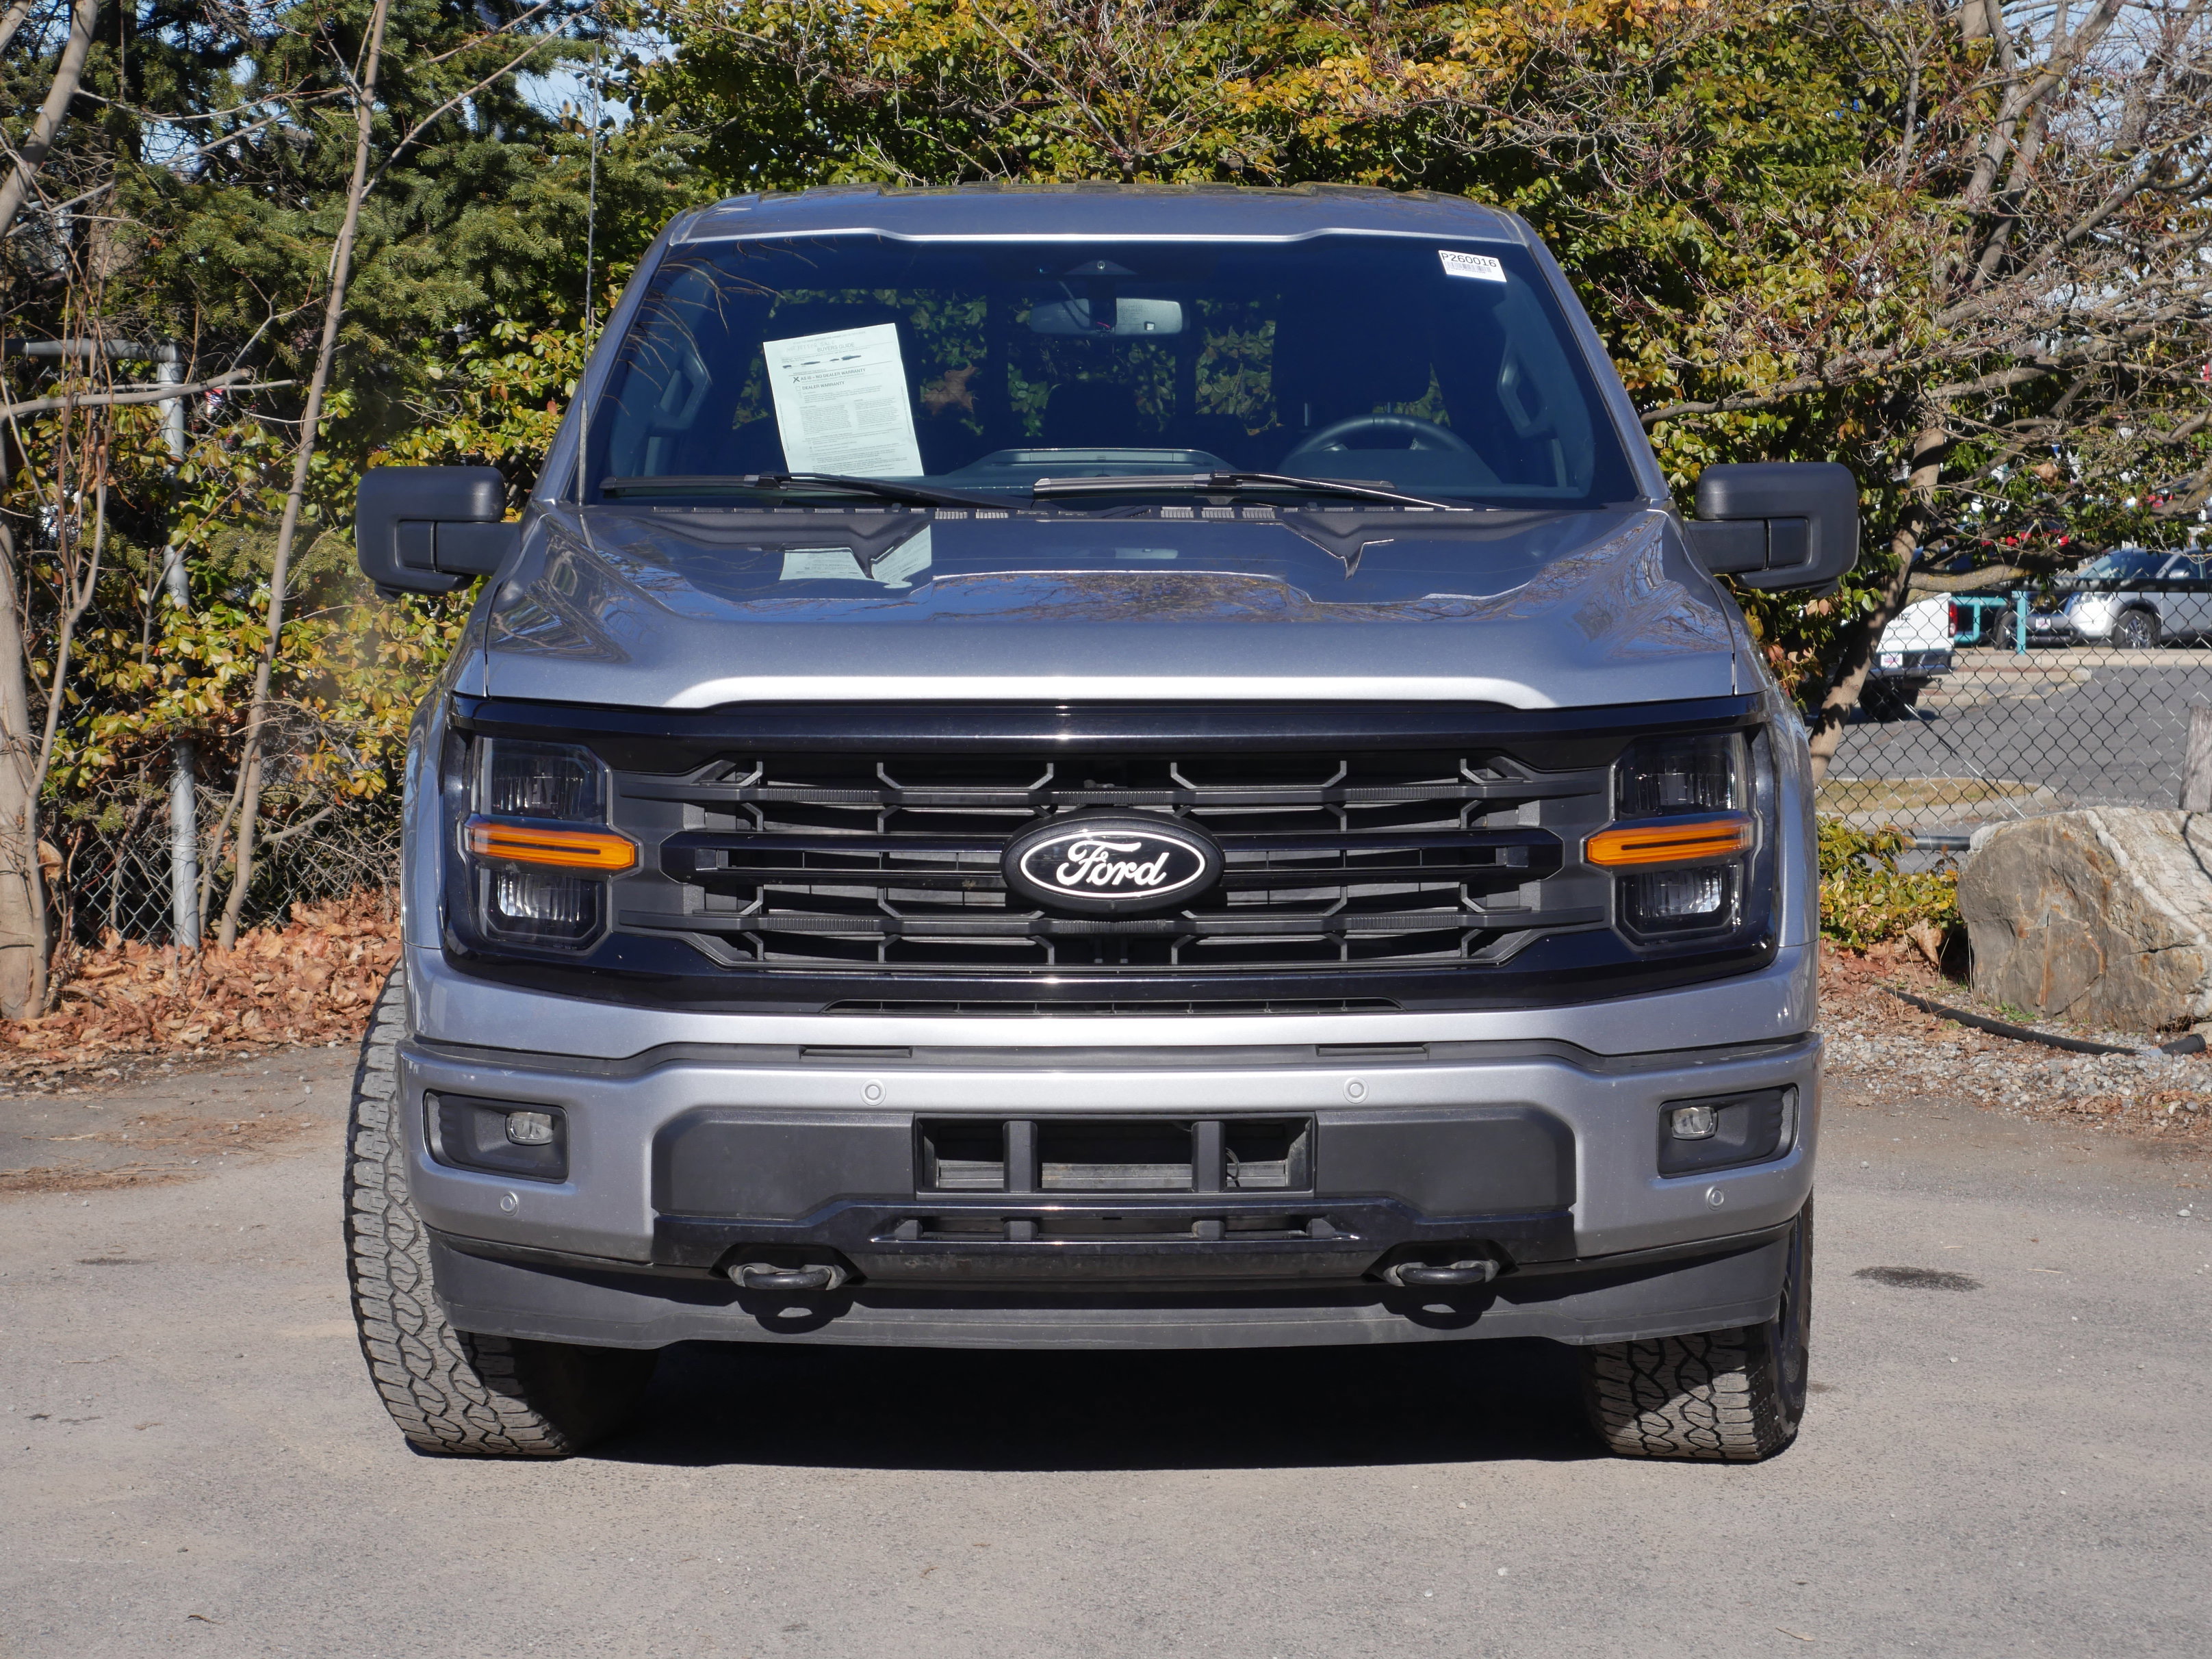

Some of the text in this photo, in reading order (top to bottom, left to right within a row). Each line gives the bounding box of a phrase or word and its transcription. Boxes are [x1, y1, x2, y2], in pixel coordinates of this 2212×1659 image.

[1441, 253, 1497, 268] P260016
[817, 344, 838, 352] BUYERS
[841, 368, 866, 376] WARRANTY
[1056, 840, 1170, 886] Ford
